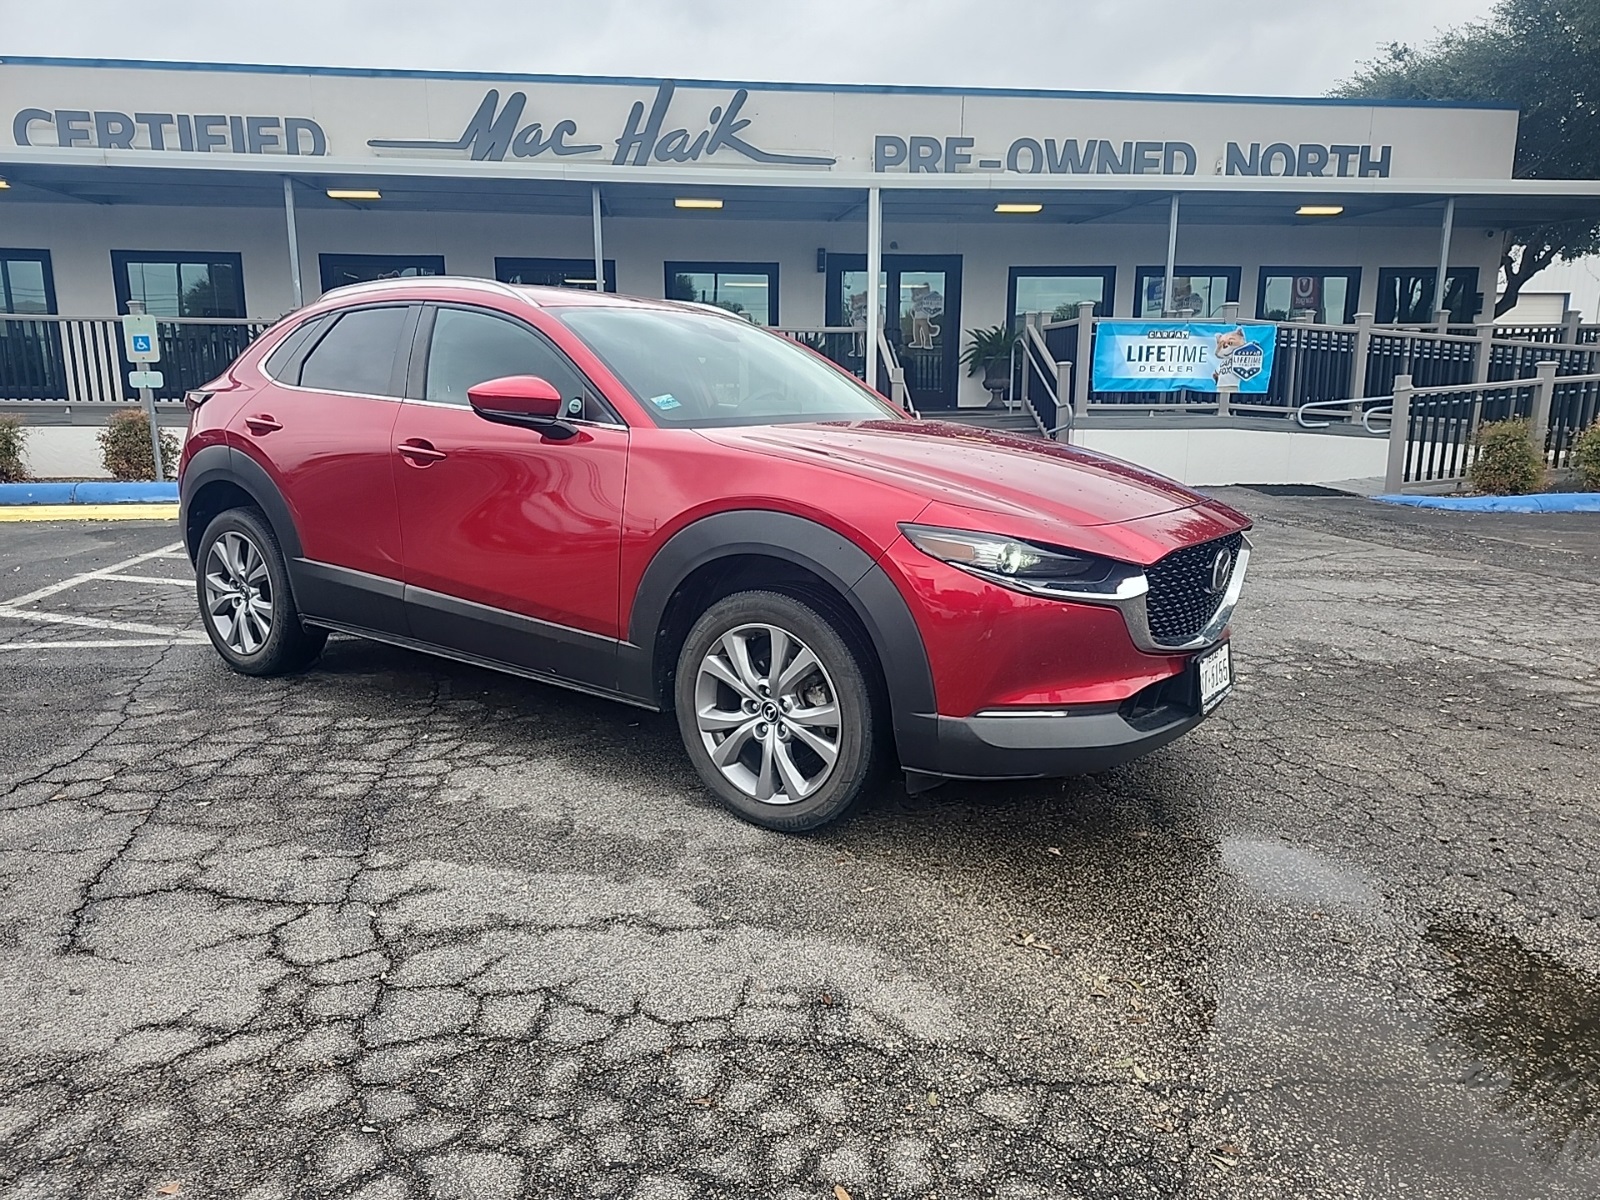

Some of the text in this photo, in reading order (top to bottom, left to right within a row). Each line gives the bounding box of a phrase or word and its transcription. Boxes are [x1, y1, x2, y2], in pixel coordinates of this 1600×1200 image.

[13, 108, 327, 156] CERTIFIED
[367, 79, 837, 166] Mac Haik
[874, 135, 1392, 178] PRE-OWNED NORTH
[1148, 330, 1190, 339] CARFAX
[1126, 345, 1208, 363] LIFETIME
[1138, 365, 1193, 373] DEALER
